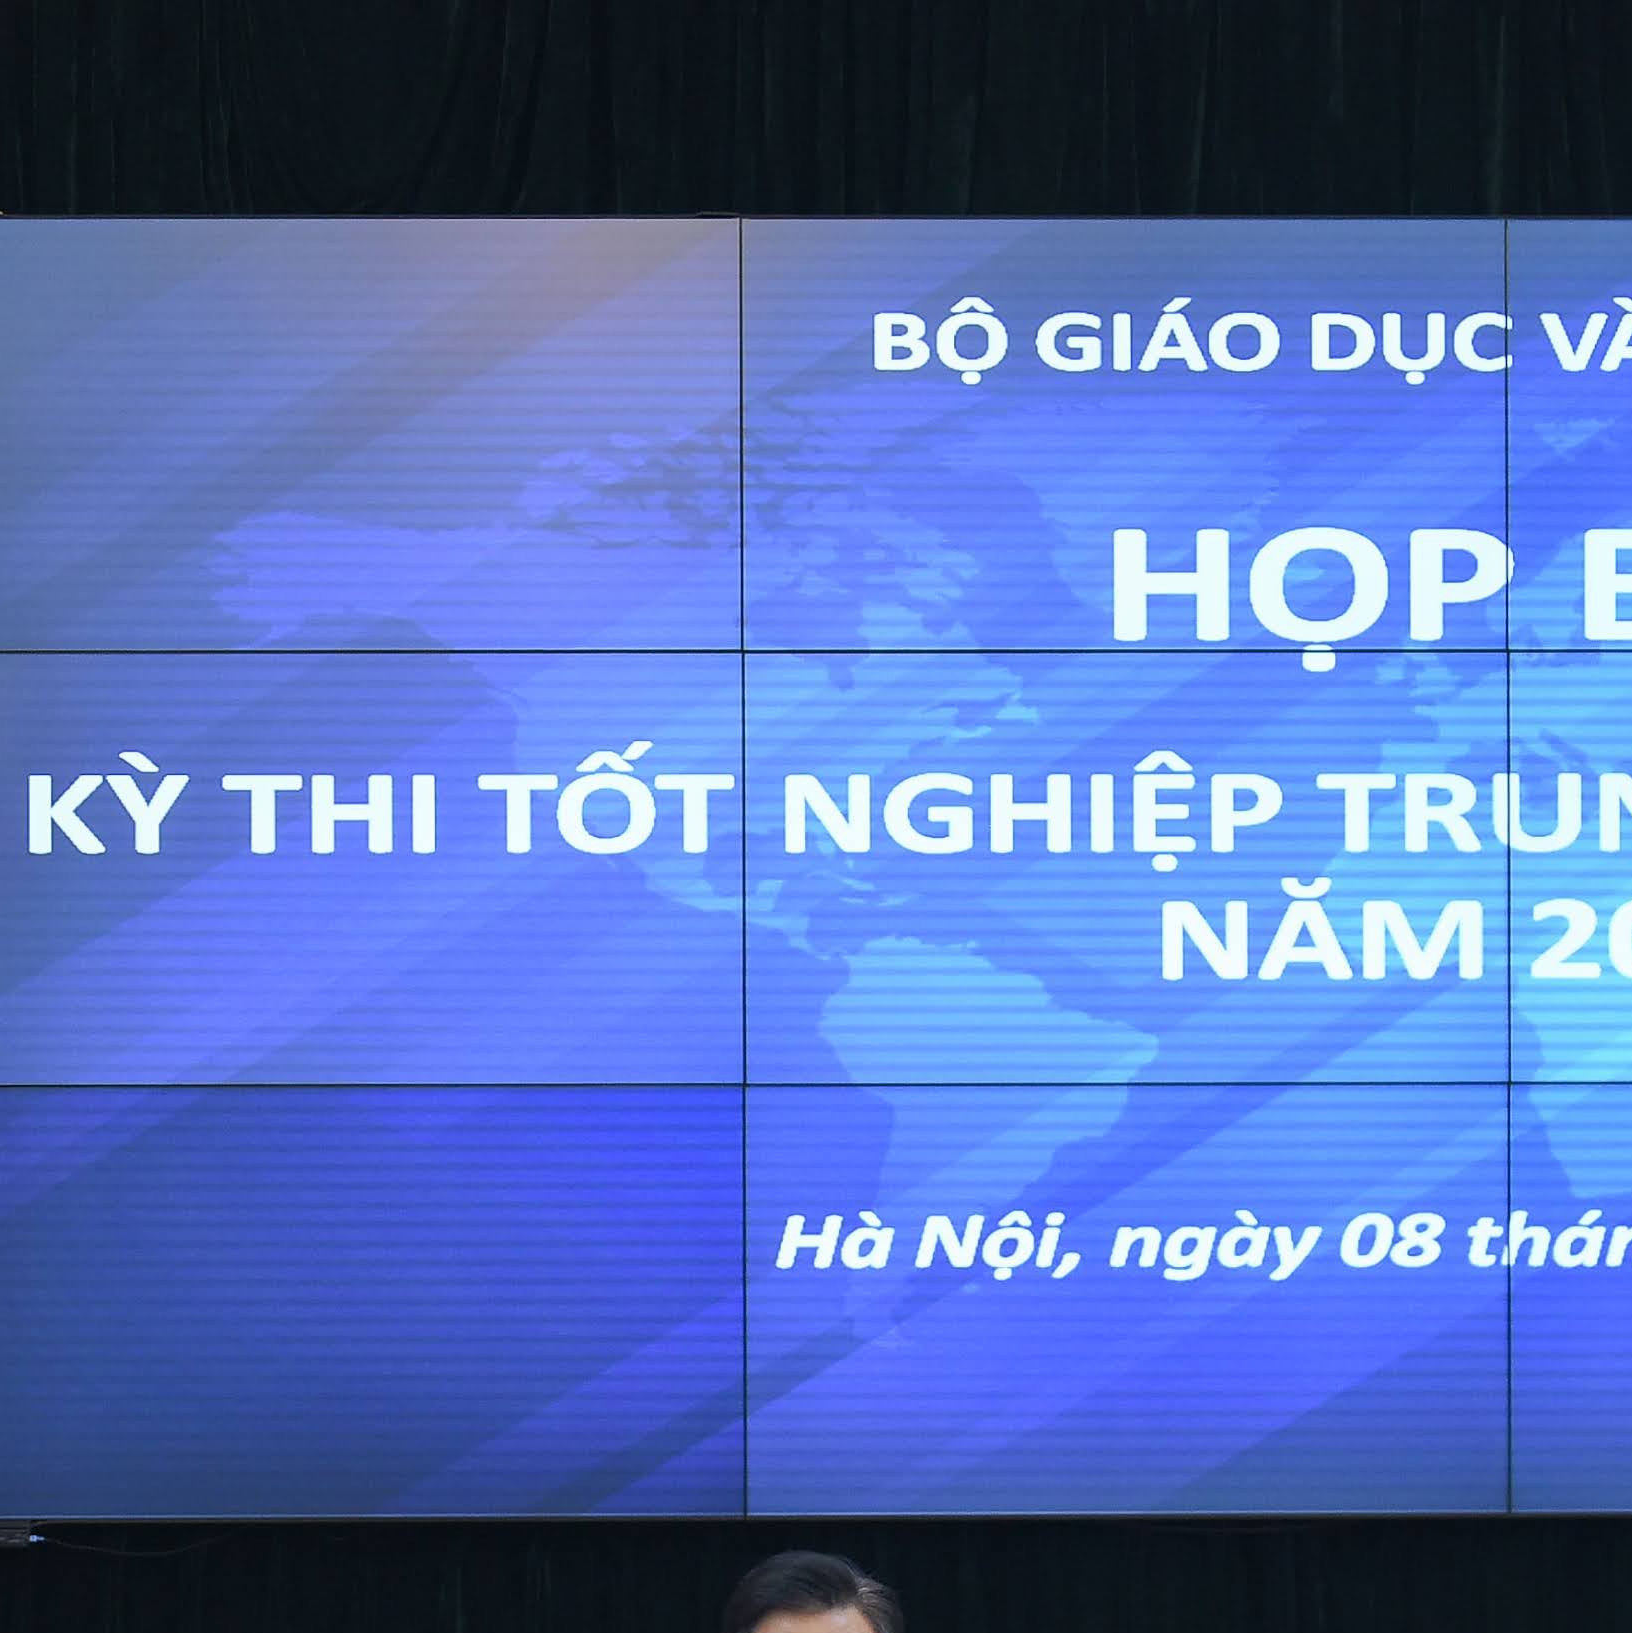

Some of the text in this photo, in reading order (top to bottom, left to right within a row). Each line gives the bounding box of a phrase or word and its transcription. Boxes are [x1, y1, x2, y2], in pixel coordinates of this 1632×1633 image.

[875, 296, 1008, 385] BỘ
[1035, 297, 1280, 372] GIÁO
[1311, 312, 1513, 385] DỤC
[1113, 526, 1515, 672] HỌP
[28, 751, 190, 855] KỲ
[222, 774, 436, 854] THI
[477, 740, 736, 854] TỐT
[784, 750, 1283, 872] NGHIỆP
[1162, 876, 1483, 981] NĂM
[776, 1211, 895, 1269] Hà
[915, 1210, 1081, 1281] Nội,
[1109, 1209, 1322, 1281] ngày
[1340, 1212, 1446, 1268] 08
